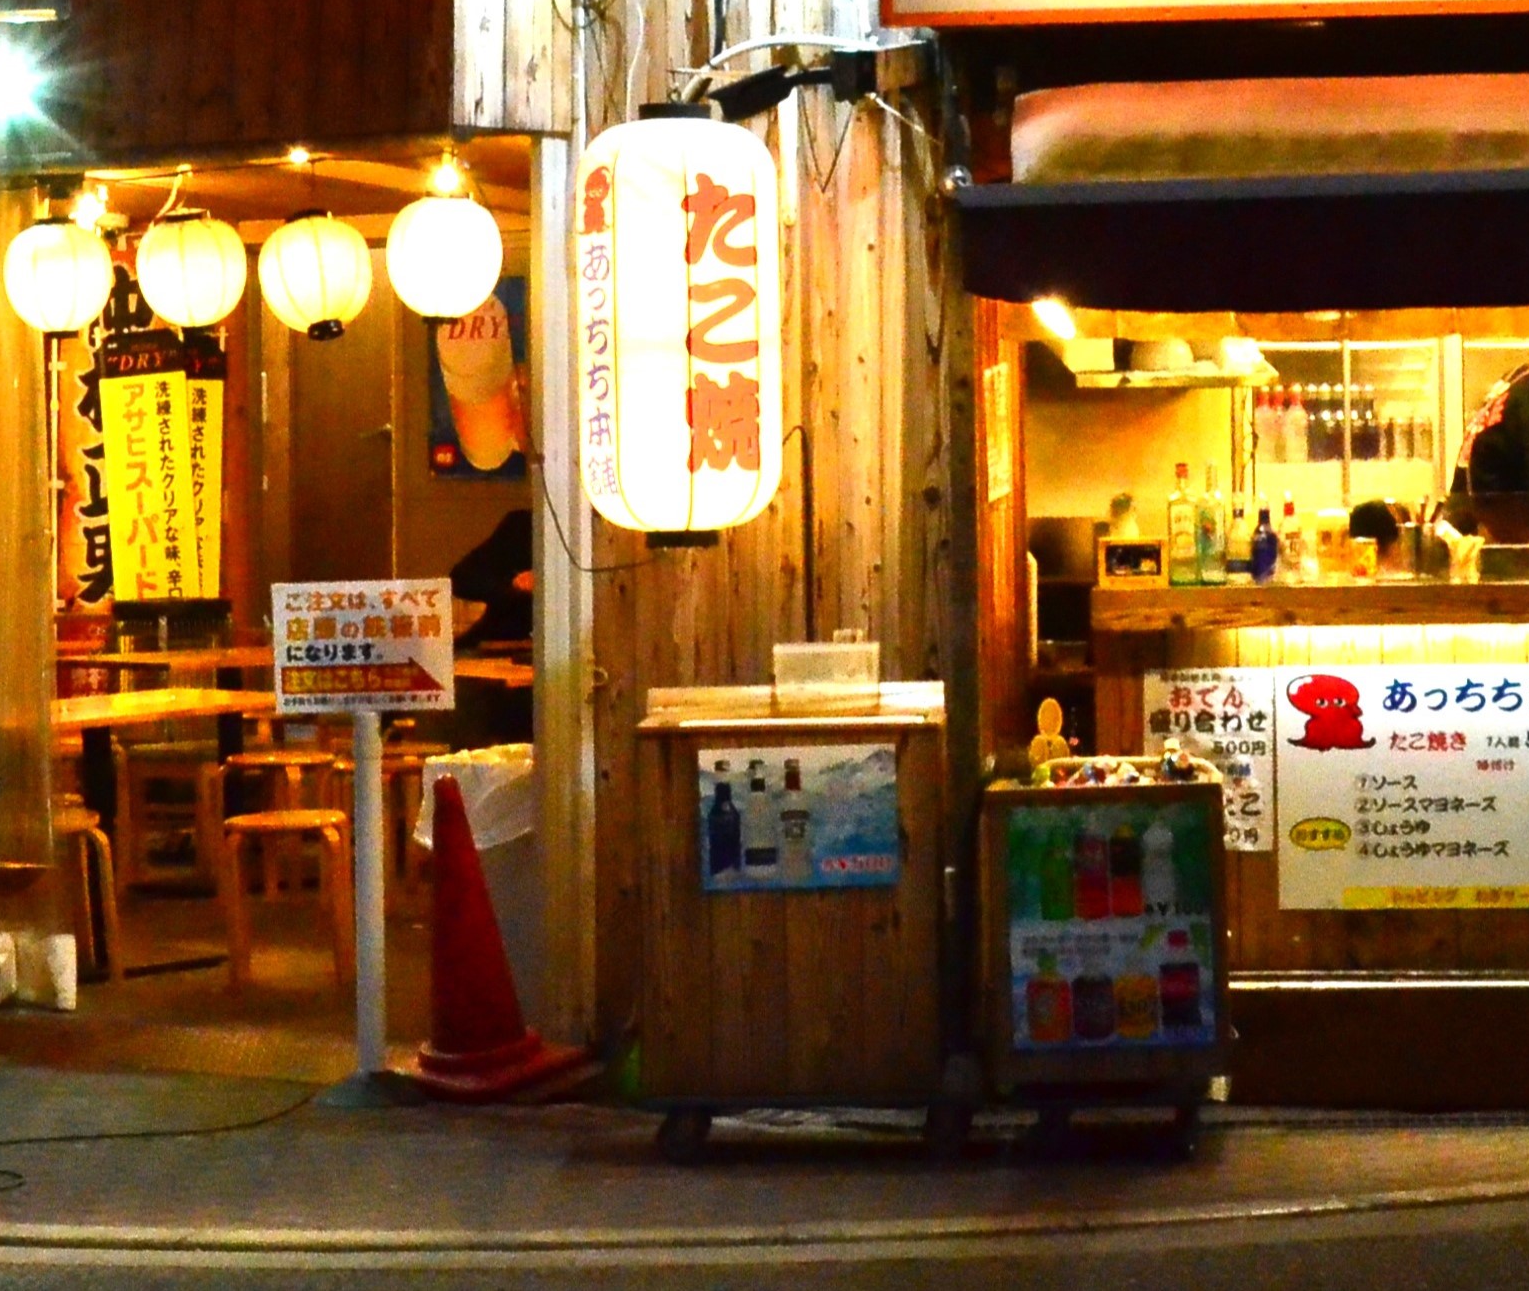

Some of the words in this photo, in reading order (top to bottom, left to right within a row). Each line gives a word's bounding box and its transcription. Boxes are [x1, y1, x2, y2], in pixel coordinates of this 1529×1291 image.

[681, 172, 761, 474] たこ焼
[582, 243, 619, 496] あっちち本舗
[285, 642, 384, 663] になります。
[1168, 685, 1245, 709] おでん
[1212, 740, 1267, 757] 500円
[1389, 731, 1468, 752] たこ焼き
